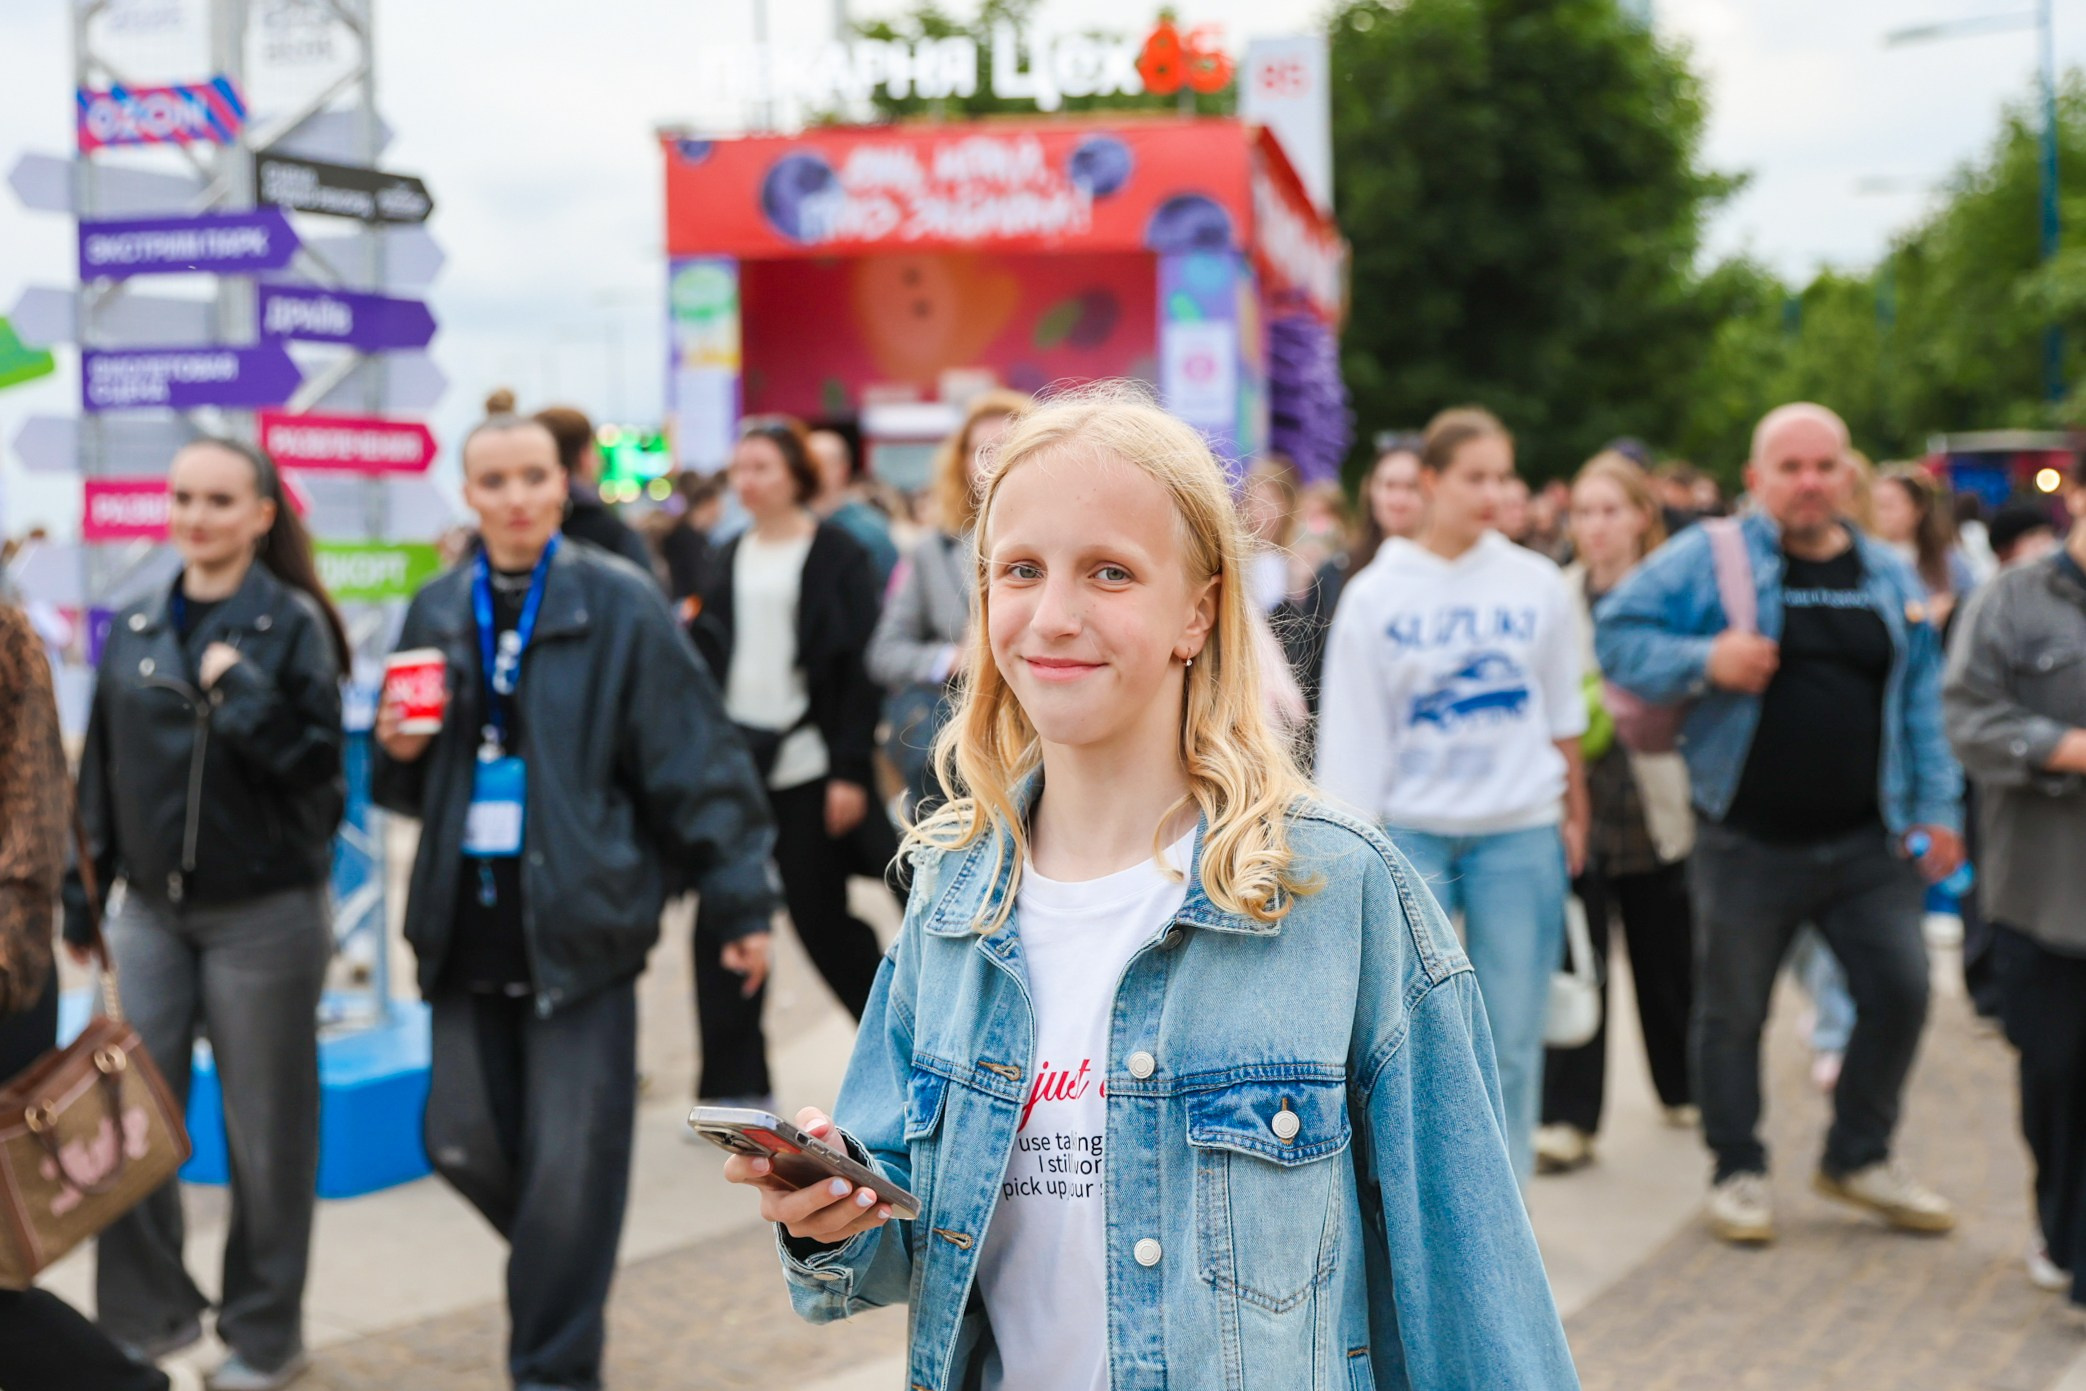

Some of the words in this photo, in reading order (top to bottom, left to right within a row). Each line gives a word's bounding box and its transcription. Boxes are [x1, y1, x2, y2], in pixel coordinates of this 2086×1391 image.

[701, 38, 978, 100] ПКАРНЯ
[86, 96, 208, 141] OZON
[316, 552, 408, 589] ДКОРТ
[1386, 606, 1535, 648] SUZUKI
[1018, 1136, 1051, 1152] use
[1038, 1155, 1044, 1173] I
[1002, 1176, 1042, 1200] pick
[1046, 1180, 1067, 1200] up
